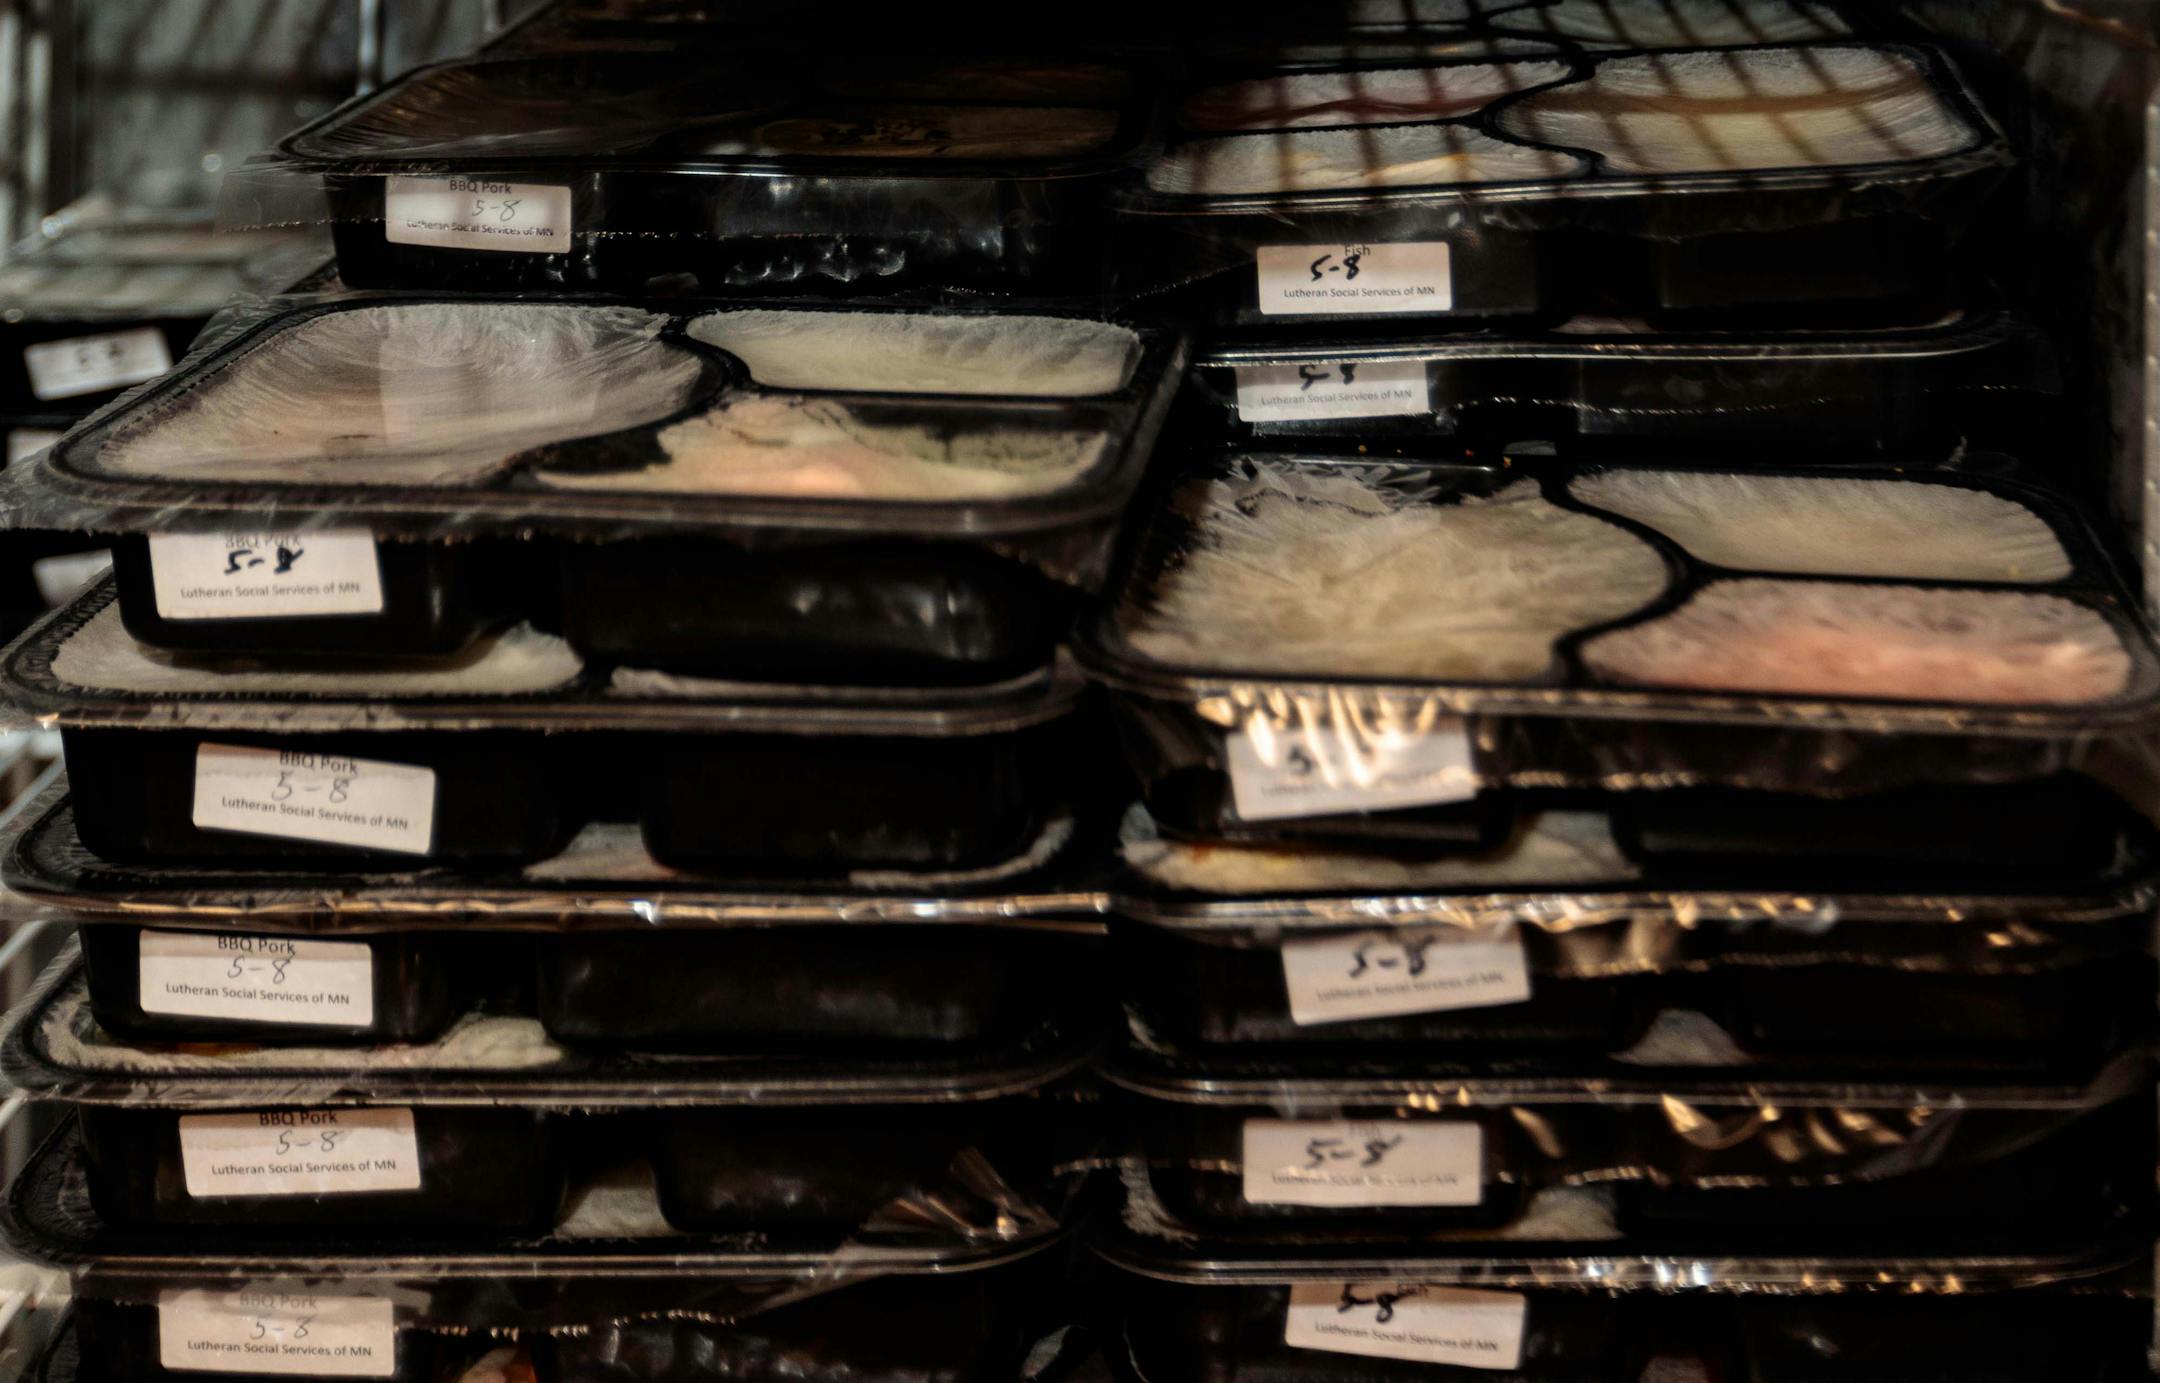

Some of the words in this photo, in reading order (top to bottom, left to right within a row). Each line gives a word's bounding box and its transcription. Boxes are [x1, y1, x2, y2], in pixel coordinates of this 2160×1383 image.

[450, 180, 477, 193] BBQ
[482, 182, 512, 194] Pork
[472, 199, 522, 222] 5-8
[1345, 244, 1371, 256] Fish
[1310, 255, 1361, 281] 5-8
[1284, 289, 1328, 298] Lutheran
[1330, 288, 1359, 297] Social
[1362, 287, 1402, 296] Services
[1404, 287, 1414, 295] of
[1417, 287, 1435, 295] MN
[1261, 396, 1302, 405] Lutheran
[1308, 394, 1336, 403] Social
[1339, 392, 1378, 402] Services
[1381, 391, 1391, 400] of
[1394, 389, 1412, 399] MN
[224, 547, 304, 574] 5-8
[181, 587, 232, 599] Lutheran
[236, 585, 268, 597] Social
[273, 584, 319, 596] Services
[323, 582, 335, 594] of
[339, 581, 360, 593] MN
[280, 752, 314, 770] BBQ
[321, 754, 358, 774] Pork
[272, 771, 350, 803] 5-8
[222, 796, 276, 813] Lutheran
[280, 804, 314, 818] Social
[318, 808, 366, 825] Services
[370, 816, 383, 827] of
[386, 818, 408, 830] MN
[218, 936, 253, 952] BBQ
[259, 938, 295, 955] Pork
[227, 953, 296, 984] 5-8
[166, 983, 219, 996] Lutheran
[223, 988, 256, 1000] Social
[260, 990, 308, 1003] Services
[312, 992, 324, 1003] of
[328, 994, 349, 1005] MN
[260, 1112, 294, 1127] BBQ
[300, 1112, 338, 1125] Pork
[276, 1130, 344, 1155] 5-8
[211, 1164, 264, 1176] Lutheran
[269, 1163, 303, 1174] Social
[306, 1161, 355, 1173] Services
[358, 1159, 370, 1171] of
[375, 1160, 396, 1170] MN
[281, 1294, 318, 1309] Pork
[188, 1340, 240, 1352] Lutheran
[244, 1342, 279, 1354] Social
[283, 1344, 331, 1356] Services
[334, 1346, 346, 1356] of
[350, 1346, 372, 1357] MN
